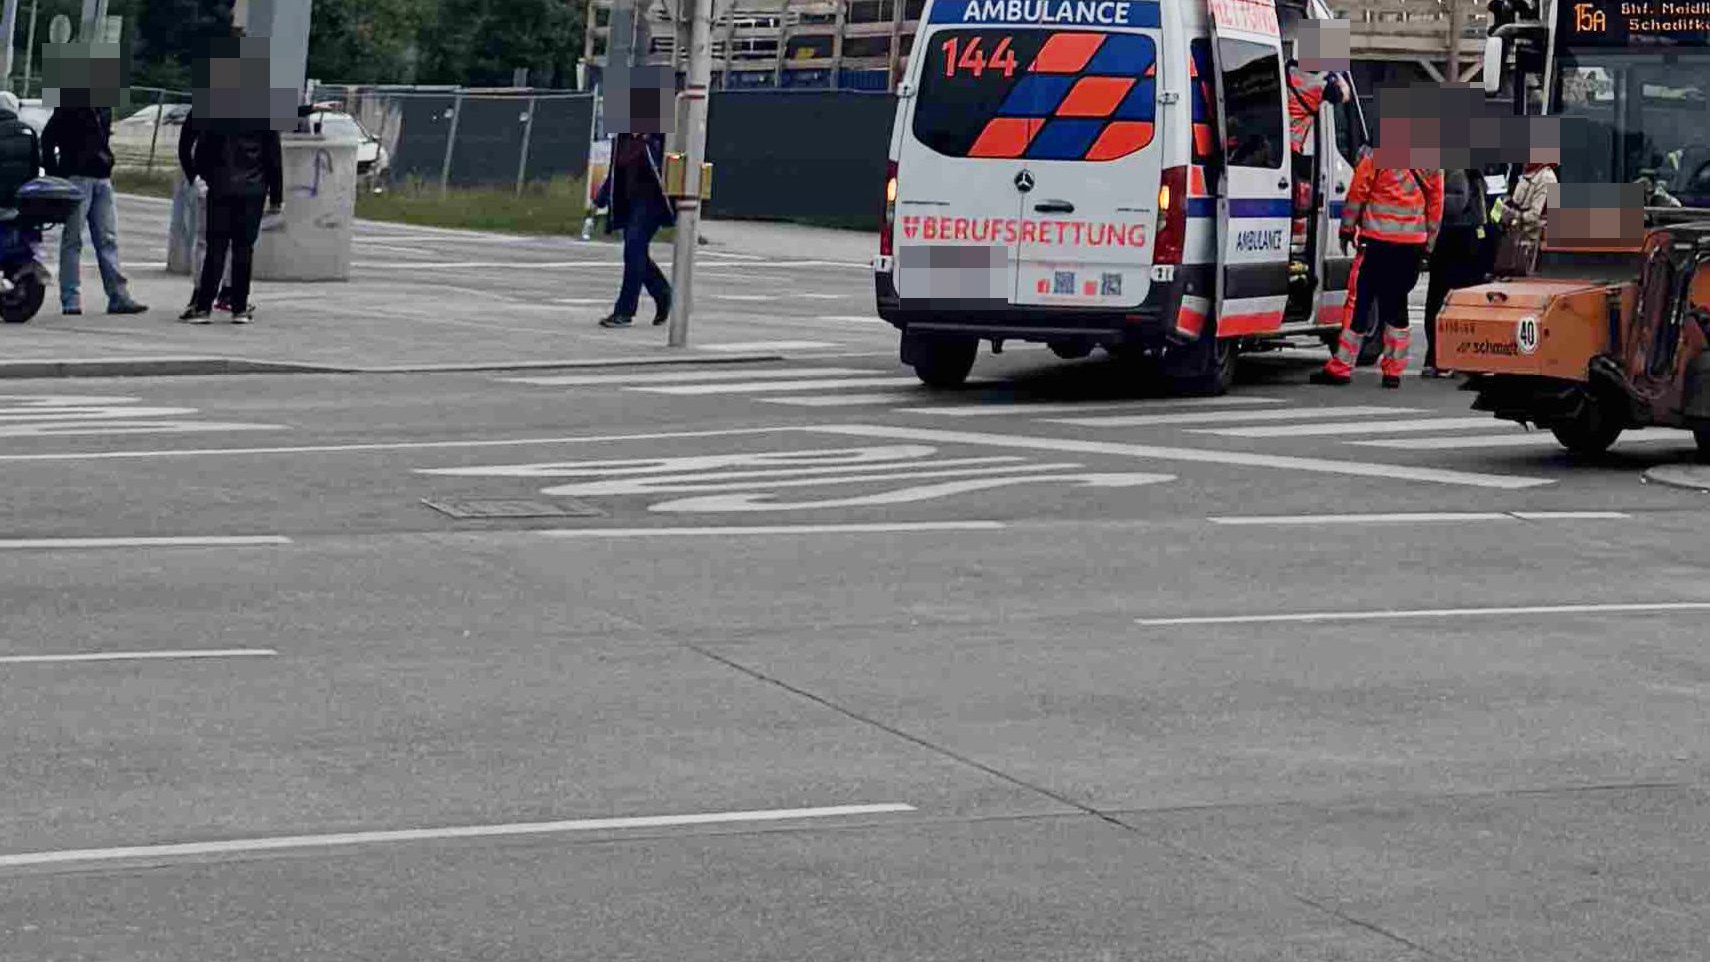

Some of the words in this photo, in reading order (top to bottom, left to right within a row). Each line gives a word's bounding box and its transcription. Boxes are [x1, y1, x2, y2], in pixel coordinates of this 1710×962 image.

[1574, 2, 1607, 32] 15A
[941, 36, 1019, 78] 144
[921, 216, 1148, 248] BERUFSRETTUNG
[1519, 320, 1535, 346] 40
